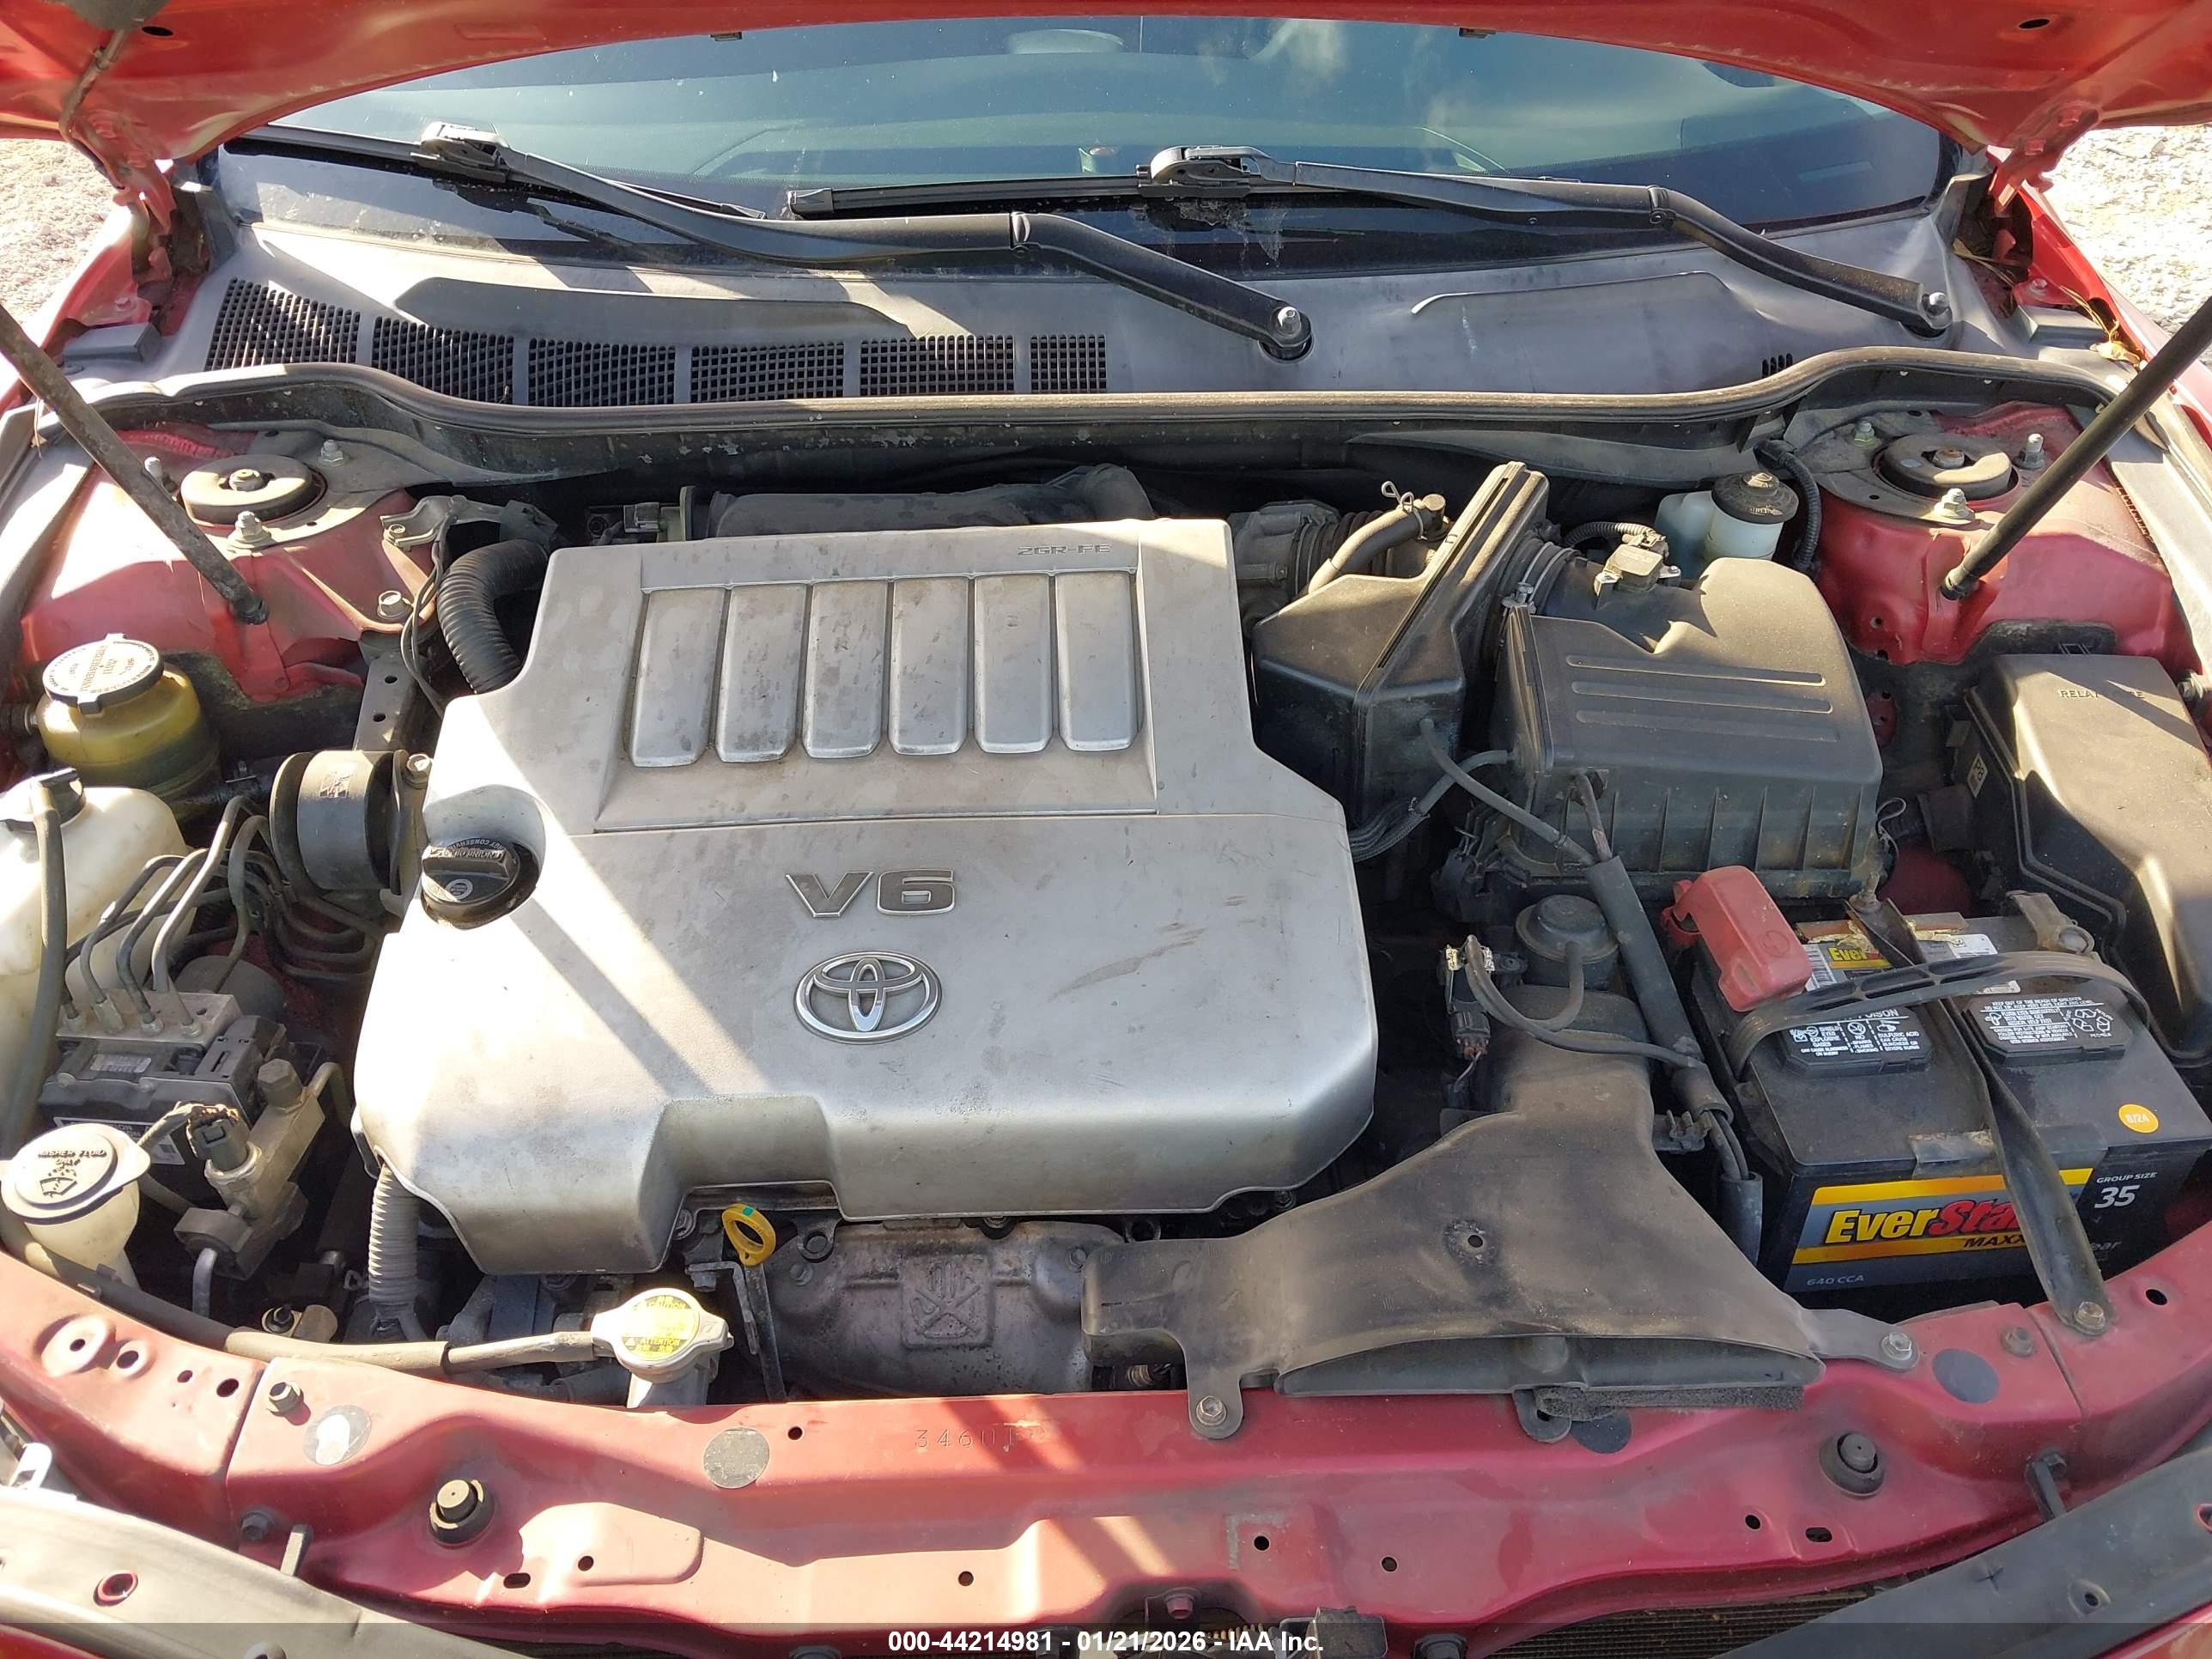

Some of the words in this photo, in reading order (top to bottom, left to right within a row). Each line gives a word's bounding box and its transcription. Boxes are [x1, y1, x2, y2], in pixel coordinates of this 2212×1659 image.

[785, 867, 956, 918] V6
[2096, 1174, 2133, 1184] GROUP
[2134, 1171, 2158, 1181] SIZE
[2094, 1184, 2141, 1209] 35
[1824, 1199, 2021, 1245] EverSta
[1806, 1276, 1835, 1286] 640
[1837, 1273, 1865, 1285] CCA
